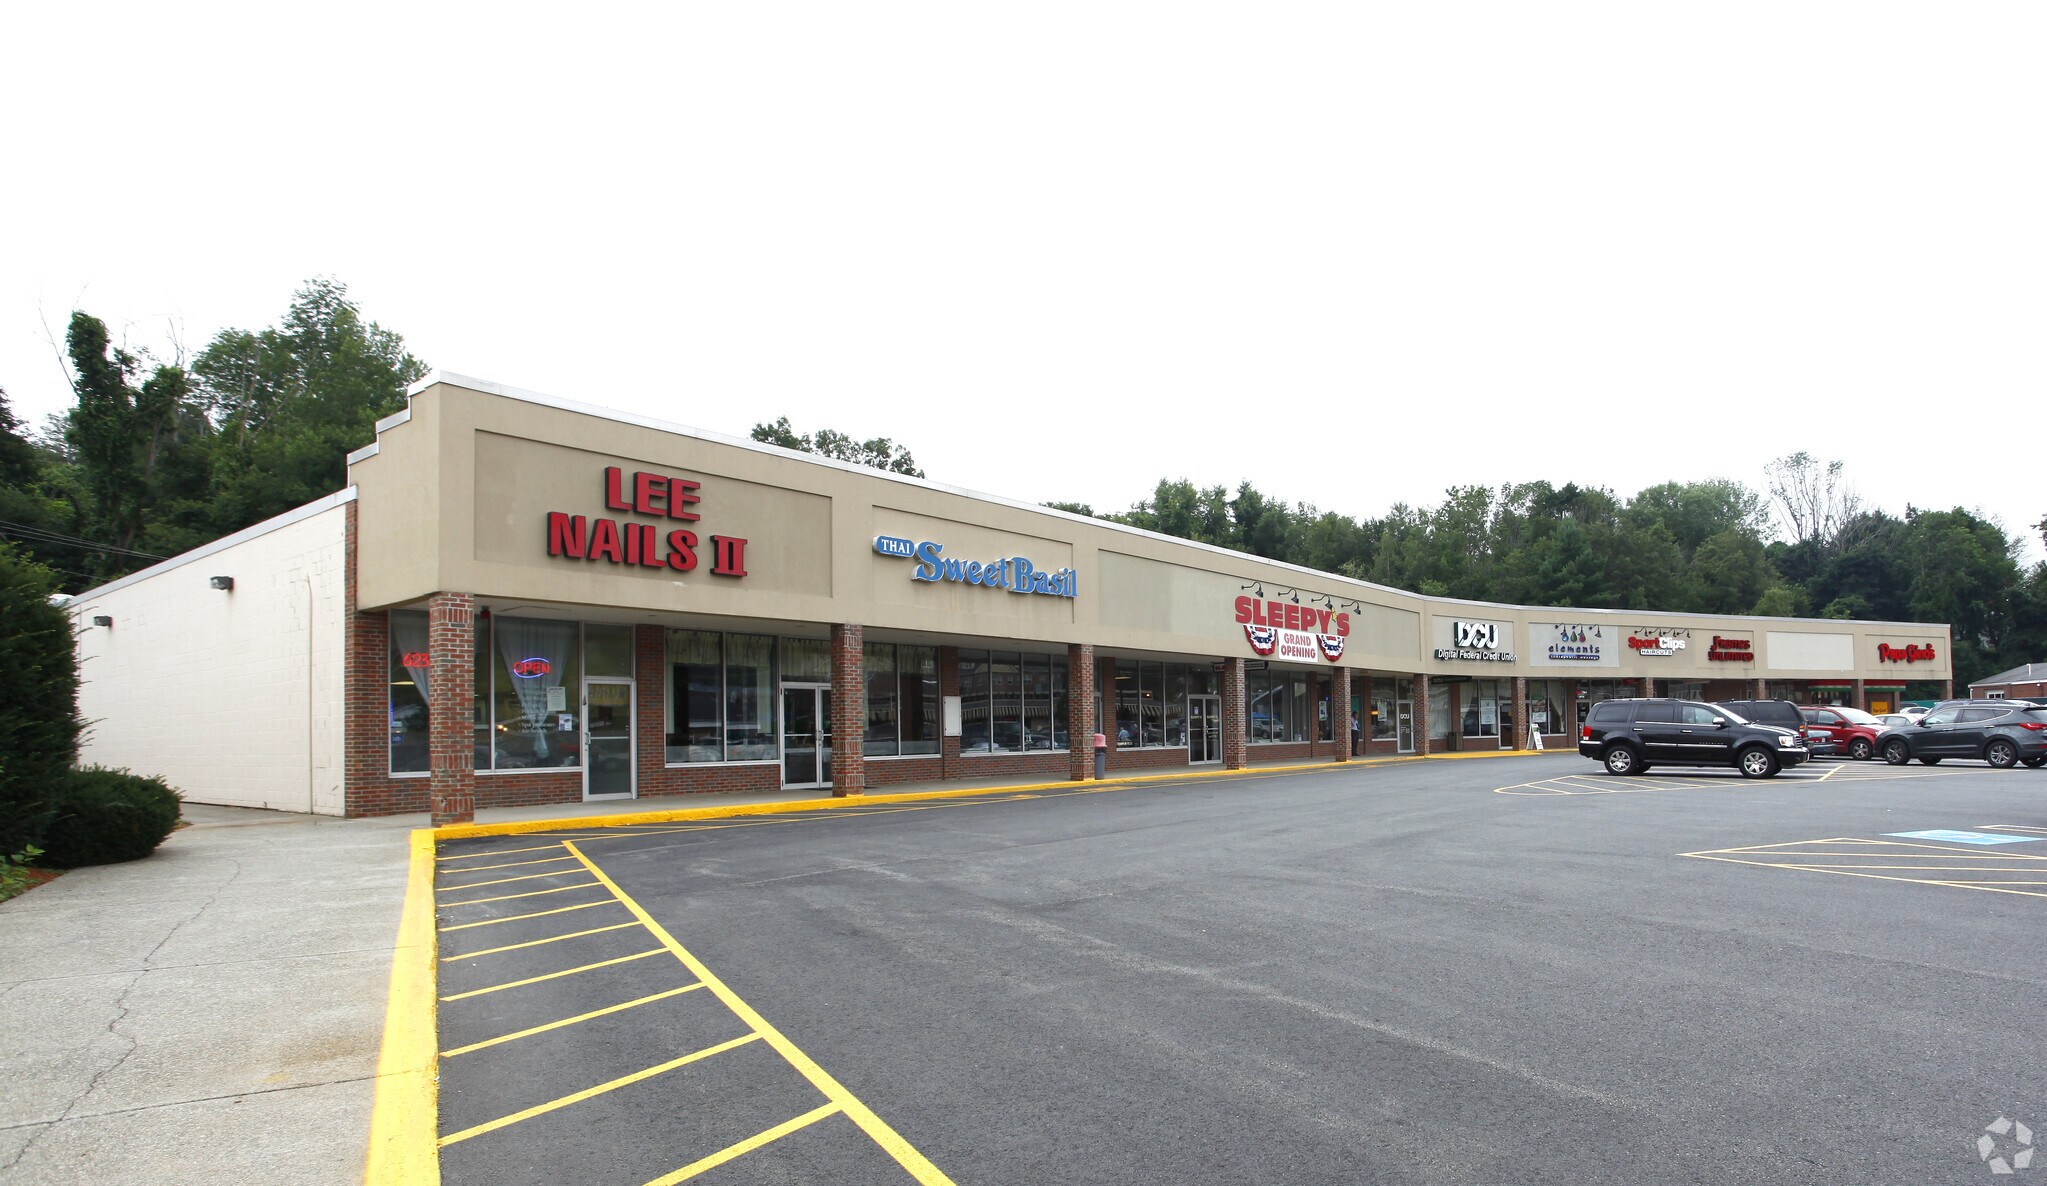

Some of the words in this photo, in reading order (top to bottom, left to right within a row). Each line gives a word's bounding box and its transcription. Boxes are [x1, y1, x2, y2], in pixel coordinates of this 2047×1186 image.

[604, 466, 700, 522] LEE
[547, 511, 698, 571] NAILS
[710, 535, 748, 577] II
[880, 538, 910, 555] THAI
[912, 540, 1010, 589] Sweet
[1008, 556, 1078, 598] Basil
[1235, 595, 1350, 637] SLEEPY'S
[1283, 632, 1312, 646] GRAND
[1455, 621, 1499, 649] DCU
[1280, 645, 1316, 659] OPENING
[1436, 648, 1459, 660] Digital
[1459, 649, 1481, 660] Federal
[1482, 651, 1500, 661] Credit
[1501, 652, 1518, 662] Union
[1548, 643, 1600, 654] elements
[1878, 642, 1906, 663] Papa
[402, 652, 430, 668] 623
[513, 661, 550, 674] OPEN
